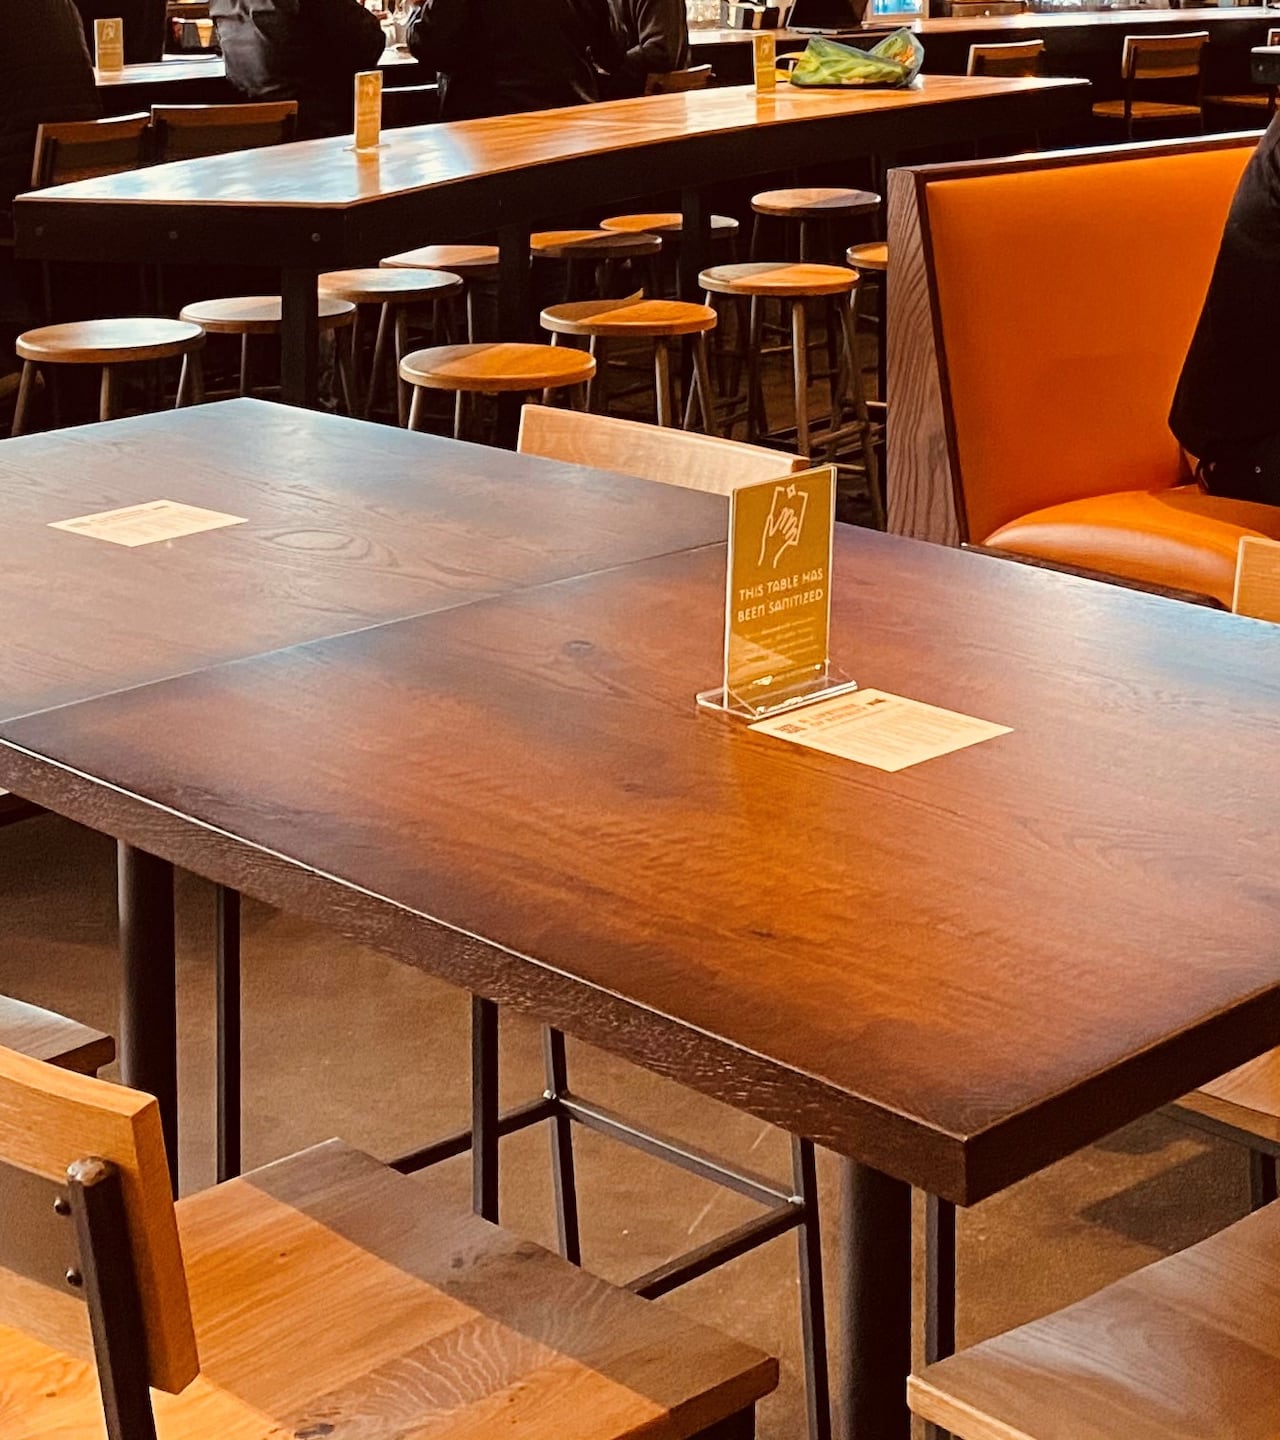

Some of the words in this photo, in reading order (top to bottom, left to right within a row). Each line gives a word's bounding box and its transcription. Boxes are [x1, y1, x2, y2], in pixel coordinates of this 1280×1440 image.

[739, 583, 764, 601] THIS
[767, 574, 800, 594] TABLE
[802, 567, 824, 585] HAS
[737, 604, 766, 623] BEEN
[768, 587, 824, 614] SANITIZED
